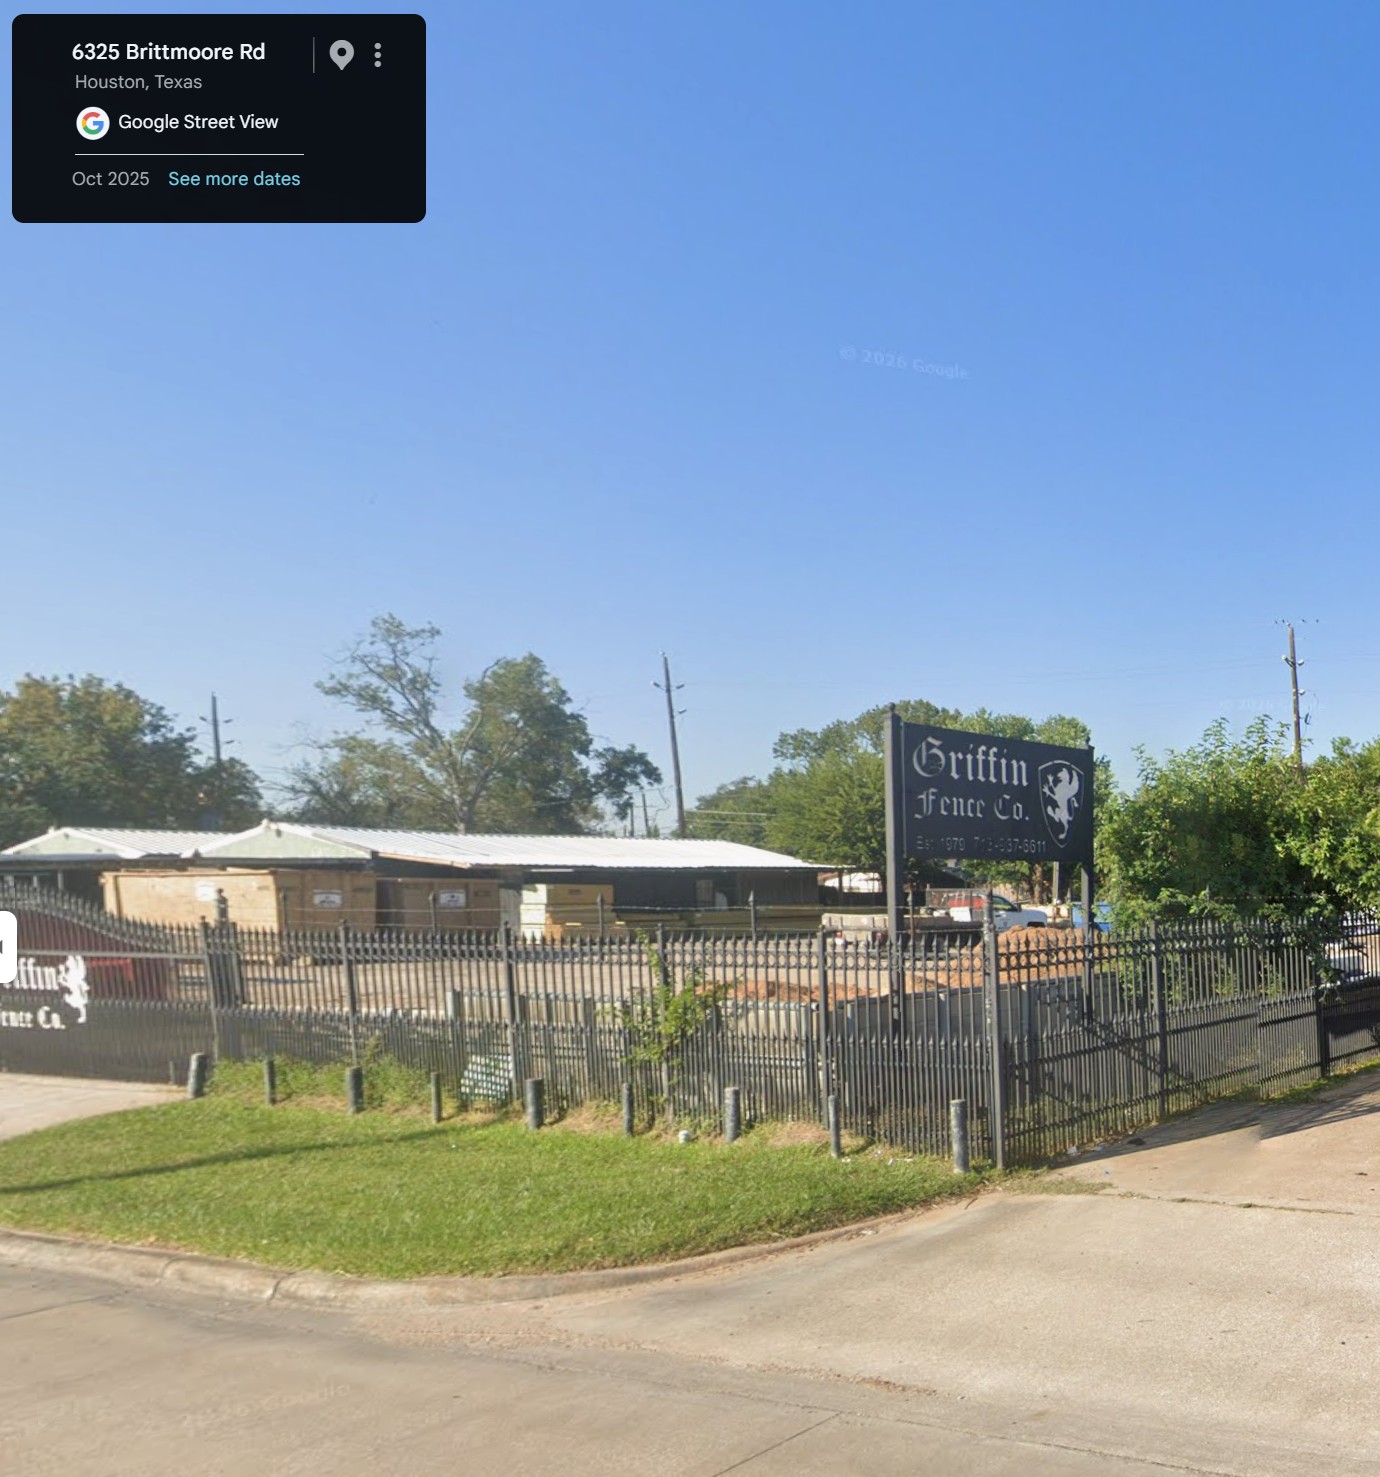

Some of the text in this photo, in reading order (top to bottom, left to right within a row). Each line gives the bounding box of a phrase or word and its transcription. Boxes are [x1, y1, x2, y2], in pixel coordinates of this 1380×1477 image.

[912, 736, 1029, 787] Griffin
[914, 787, 1030, 821] Fence Co.
[940, 837, 965, 851] 979
[3, 957, 60, 990] ffin
